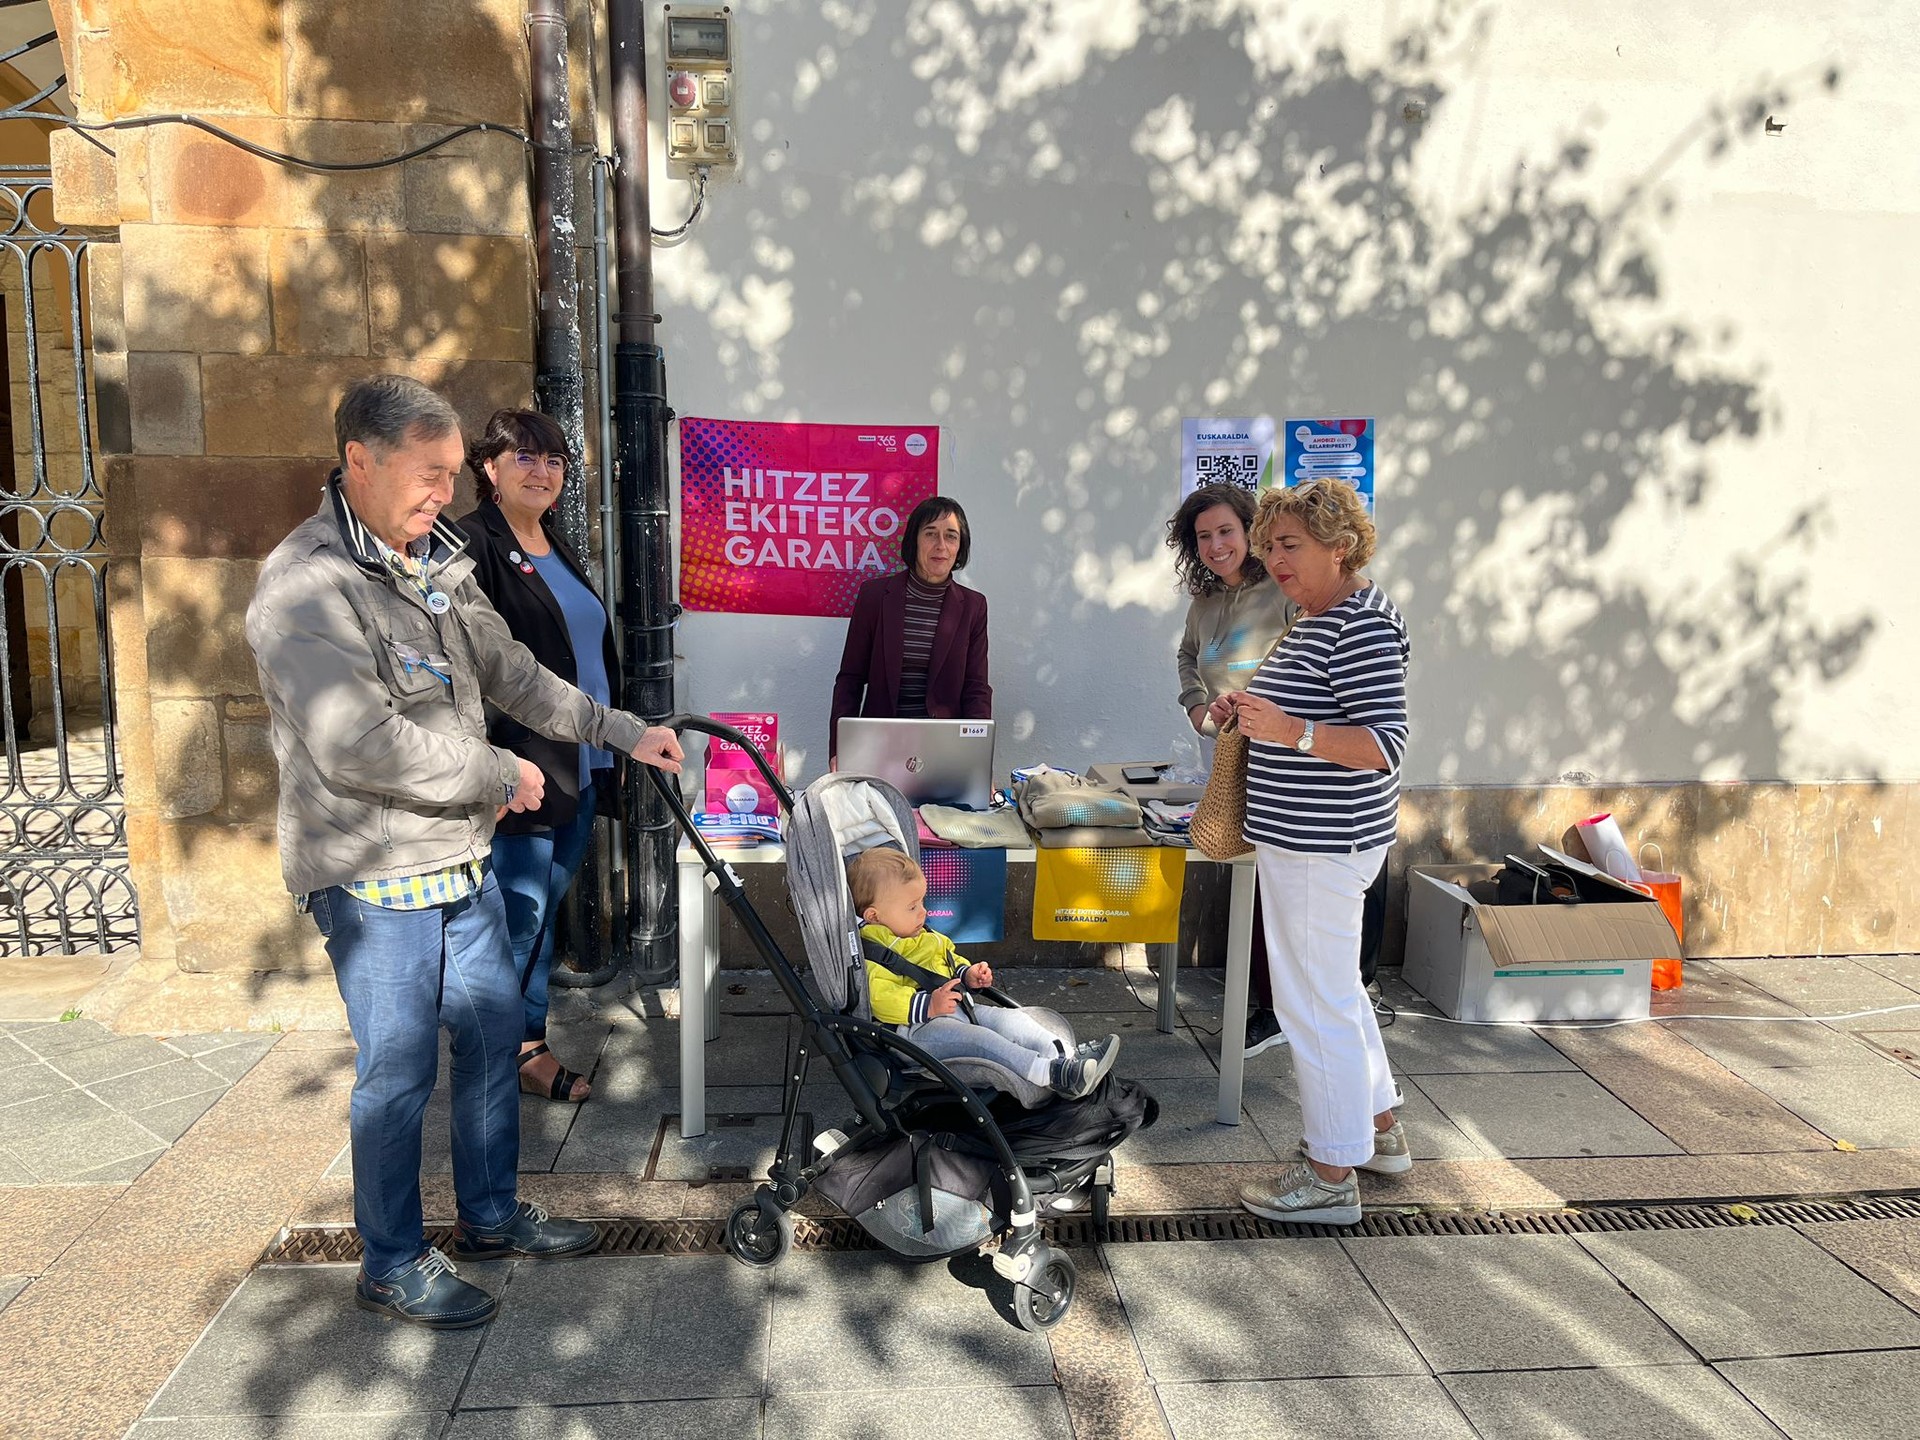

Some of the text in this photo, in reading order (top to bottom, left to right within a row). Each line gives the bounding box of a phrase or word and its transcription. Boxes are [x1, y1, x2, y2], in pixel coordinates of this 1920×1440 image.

[877, 435, 897, 446] 365
[723, 466, 871, 502] HITZEZ
[725, 501, 899, 537] EKITEKO
[724, 535, 886, 570] GARAIA
[733, 725, 762, 733] TZEZ
